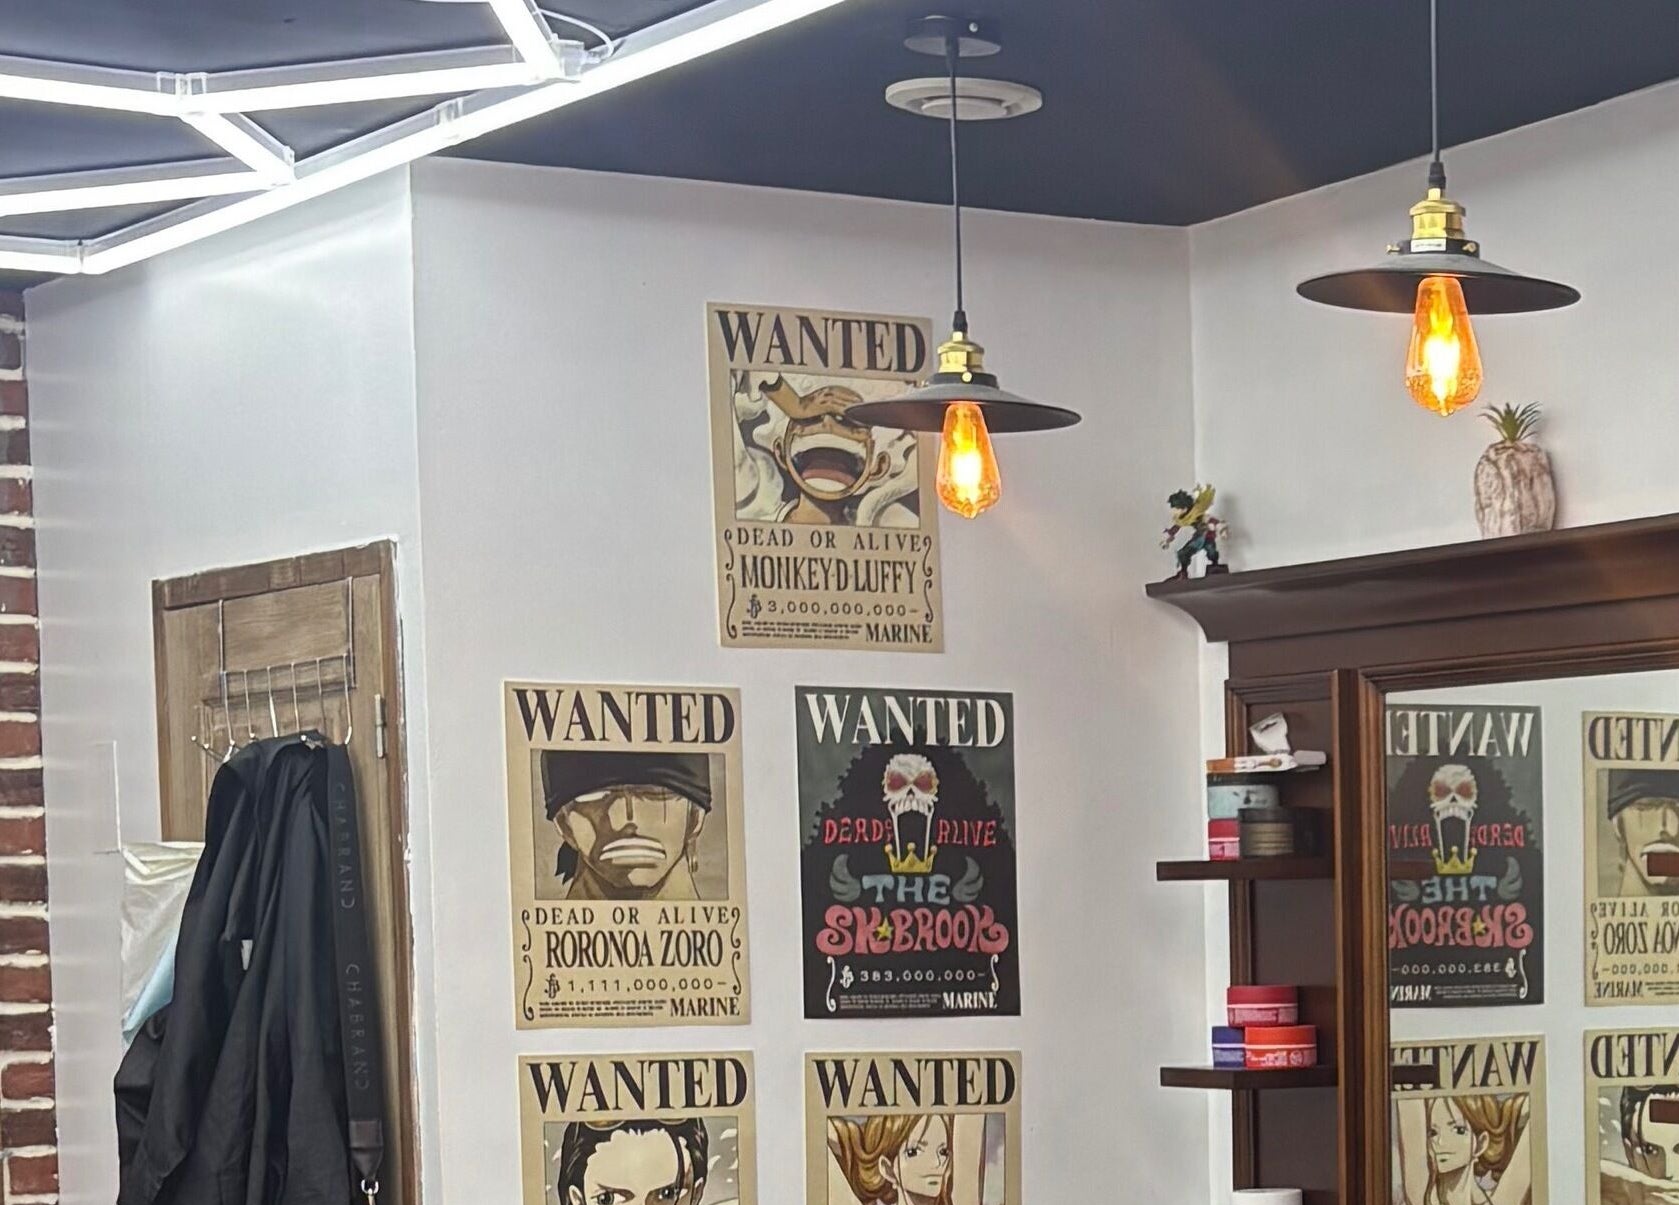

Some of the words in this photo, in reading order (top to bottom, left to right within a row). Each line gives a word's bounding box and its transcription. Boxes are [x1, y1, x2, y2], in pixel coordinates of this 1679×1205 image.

[714, 309, 928, 374] WANTED
[737, 527, 793, 548] DEAD
[810, 531, 836, 549] OR
[854, 533, 922, 552] ALIVE
[865, 623, 932, 643] MARINE
[512, 687, 735, 744] WANTED
[805, 693, 1005, 747] WANTED
[937, 819, 996, 846] ALIVE
[862, 874, 950, 904] THE
[535, 908, 594, 925] DEAD
[612, 907, 639, 924] OR
[658, 907, 729, 925] ALIVE
[545, 930, 654, 968] RORONOA
[660, 930, 723, 967] ZORO
[670, 997, 740, 1017] MARINE
[943, 991, 998, 1009] MARINE
[527, 1057, 748, 1115] WANTED
[812, 1057, 1016, 1109] WANTED
